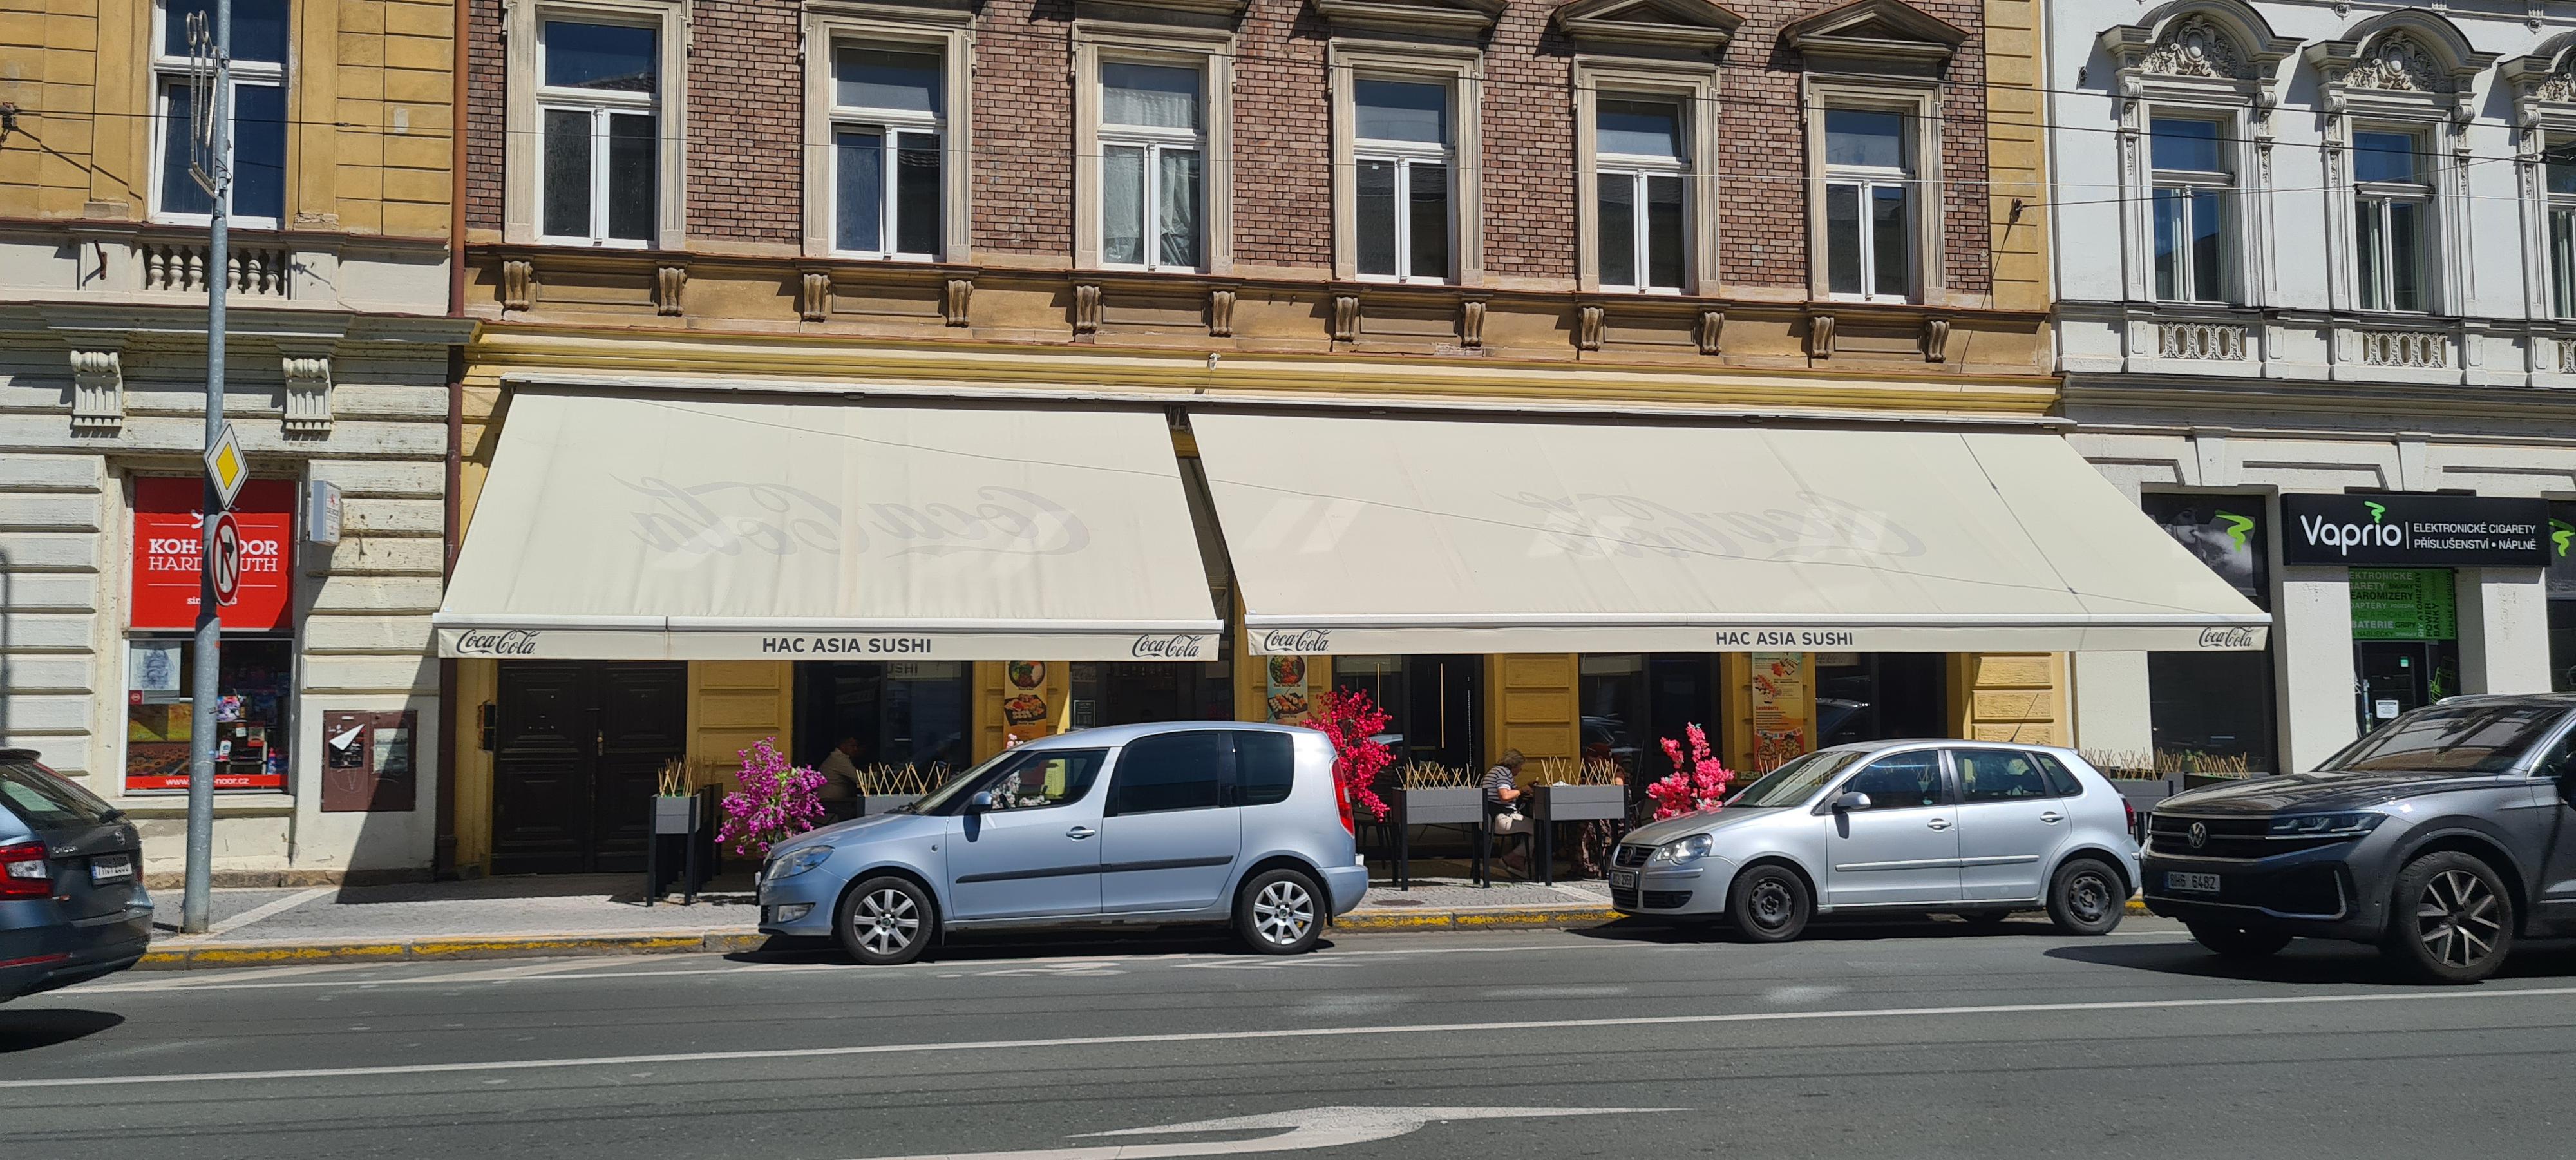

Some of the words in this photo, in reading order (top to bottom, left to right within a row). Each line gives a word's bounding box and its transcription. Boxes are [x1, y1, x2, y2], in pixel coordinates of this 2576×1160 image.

[2300, 514, 2402, 556] Vaprio
[2413, 522, 2487, 533] ELEKTRONICKÉ
[2488, 523, 2536, 535] CIGARETY
[148, 538, 278, 555] KOH-OR
[2414, 537, 2489, 549] PŘÍSLUŠENSTVÍ
[2499, 538, 2537, 550] NÁPLNĚ
[2351, 591, 2414, 600] EAROMIZERY
[2432, 603, 2440, 637] BANKY
[456, 629, 541, 654] Coca-Cola
[762, 638, 805, 653] HAC
[811, 638, 862, 653] ASIA
[868, 638, 931, 653] SUSHI
[1132, 634, 1205, 658] Coca-Cola
[1264, 629, 1334, 652] Coca-Cola
[1716, 632, 1750, 645] HAC
[1756, 632, 1797, 645] ASIA
[1801, 632, 1853, 646] SUSHI
[2199, 625, 2254, 648] Coca-Cola
